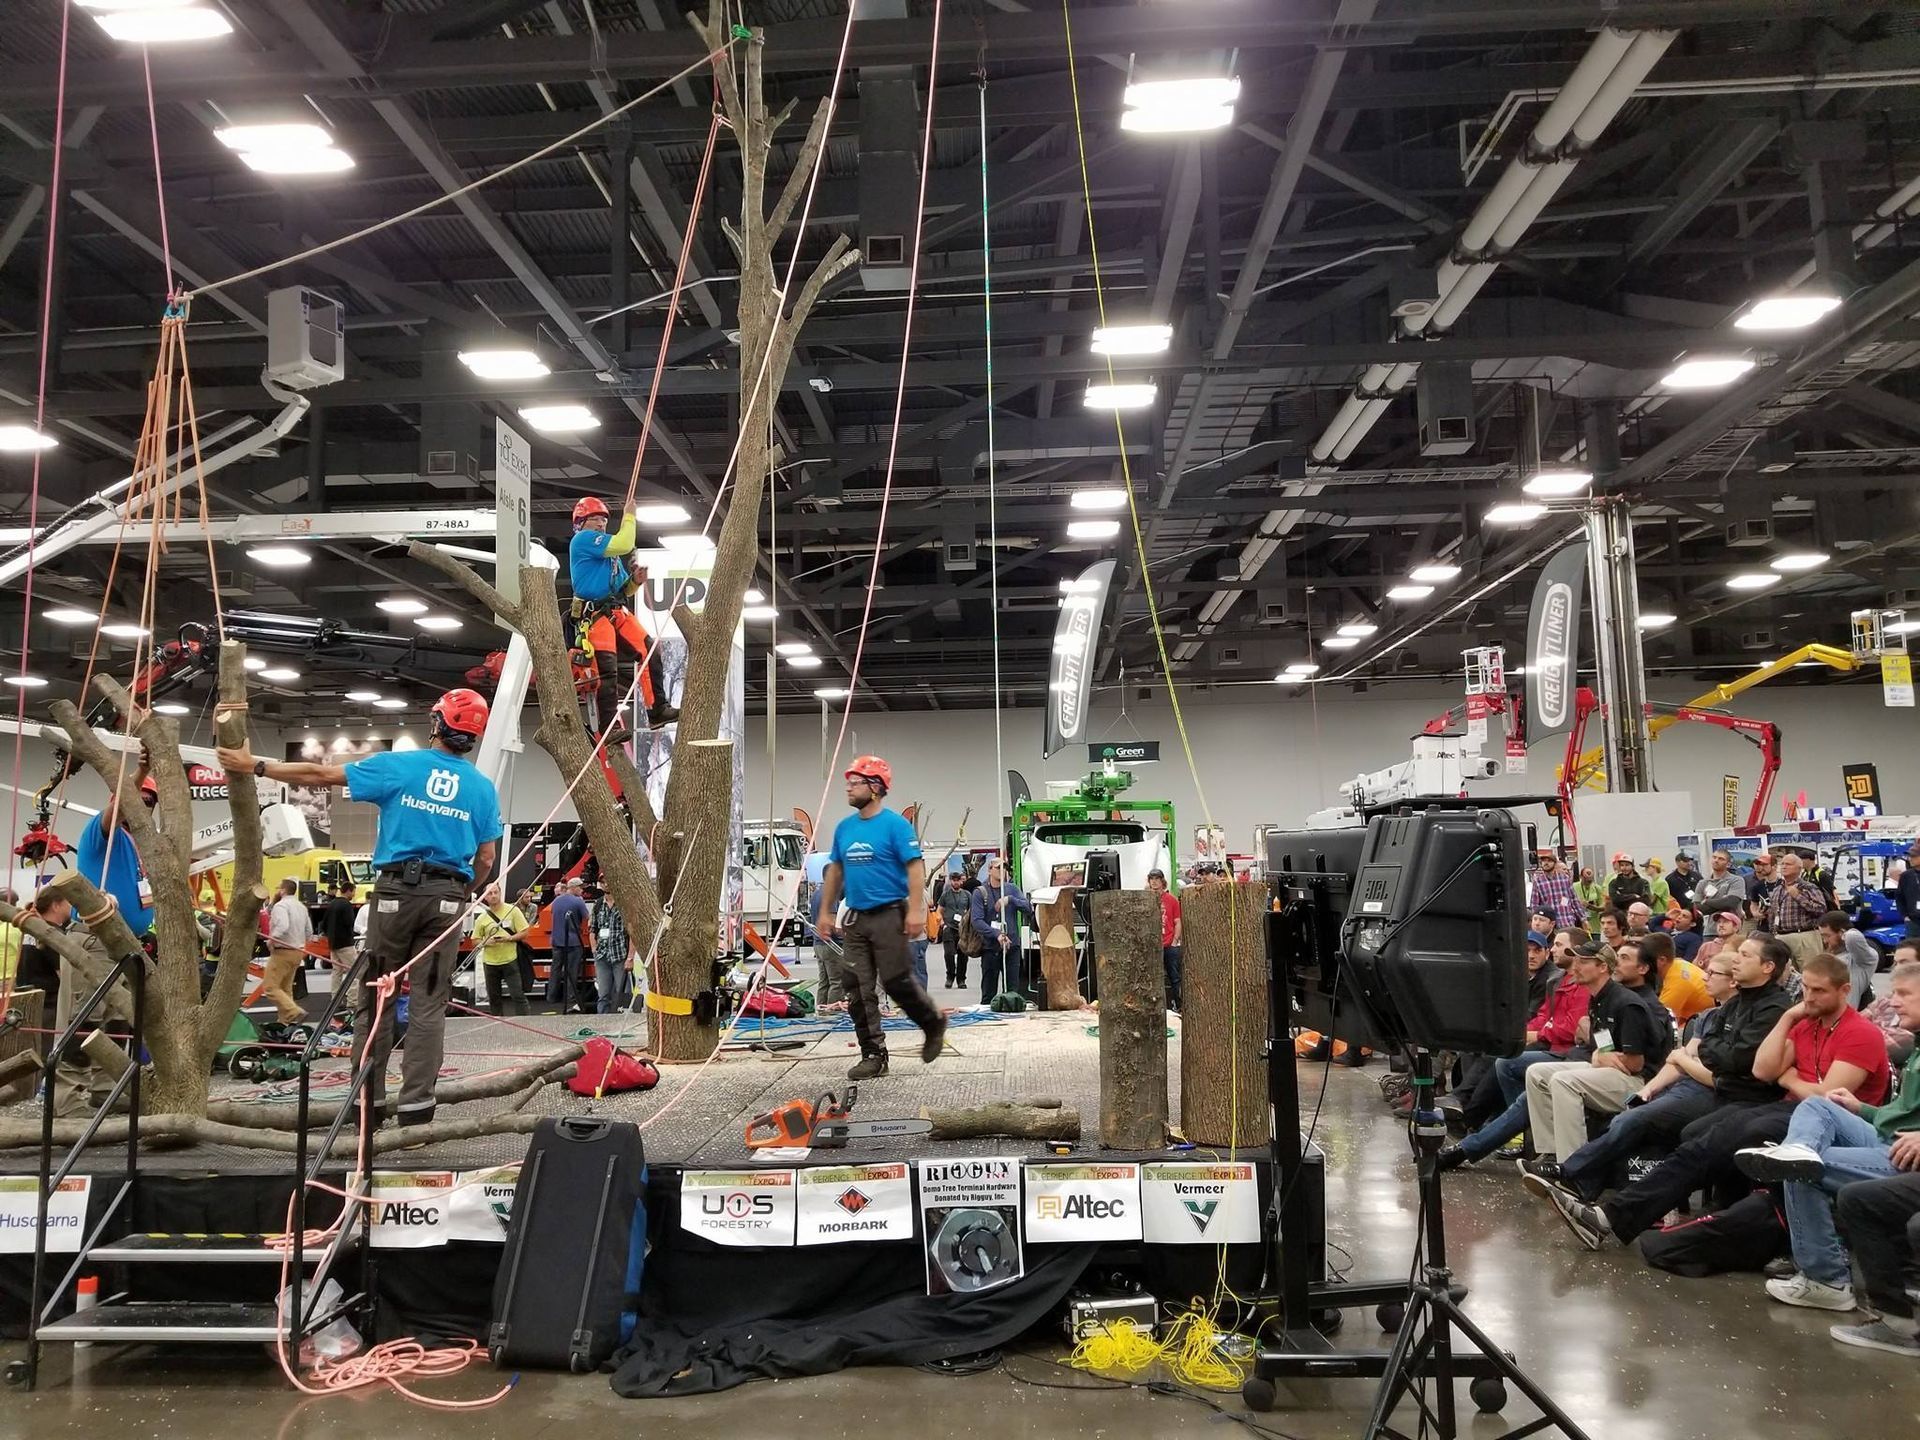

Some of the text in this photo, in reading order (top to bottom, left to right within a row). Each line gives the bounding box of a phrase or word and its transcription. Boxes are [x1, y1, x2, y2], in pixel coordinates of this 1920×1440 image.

[512, 452, 529, 478] EXPO
[500, 487, 514, 511] Aisle
[426, 520, 469, 529] 87-48AJ
[1115, 747, 1145, 756] Green
[400, 794, 470, 821] Husqvarna
[200, 820, 234, 839] 70-36A
[1365, 880, 1388, 900] JBL
[877, 1124, 907, 1132] Husqvarna
[867, 1171, 889, 1180] EXPO
[926, 1162, 1011, 1181] RIGGUY
[1096, 1172, 1119, 1180] EXPO
[1147, 1169, 1197, 1181] EXPERIENCE
[415, 1179, 437, 1187] EXPO
[753, 1178, 775, 1186] EXPO
[483, 1186, 515, 1197] Verm
[1174, 1183, 1225, 1194] Vermeer
[934, 1194, 961, 1202] Donated
[961, 1194, 970, 1202] by
[1063, 1195, 1125, 1219] Altec
[381, 1203, 439, 1226] Altec
[0, 1213, 78, 1228] Husqarna
[701, 1220, 772, 1230] FORESTRY
[818, 1220, 888, 1234] MORBARK
